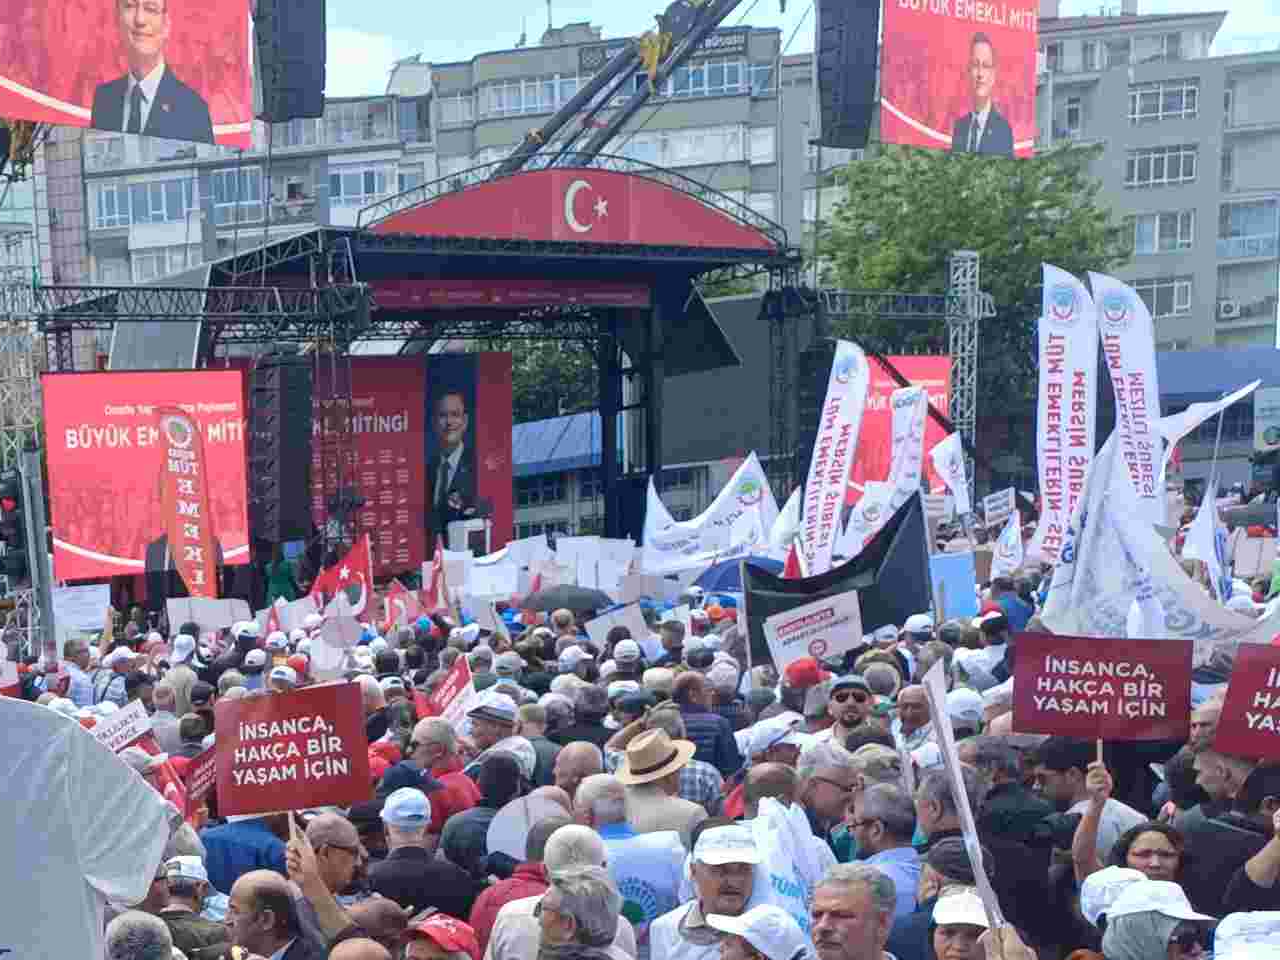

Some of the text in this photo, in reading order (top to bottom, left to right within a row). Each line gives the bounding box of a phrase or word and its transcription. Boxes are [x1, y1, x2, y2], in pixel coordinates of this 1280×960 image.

[65, 421, 131, 449] BÜYÜK
[1044, 655, 1156, 680] İNSANCA,
[1036, 676, 1164, 699] HAKÇA BİR
[1032, 695, 1167, 719] YAŞAM İÇİN
[239, 714, 335, 742] İNSANCA,
[1245, 711, 1280, 733] YA
[234, 733, 343, 765] HAKÇA BİR
[232, 761, 298, 786] YAŞAM
[303, 756, 348, 779] İÇİN
